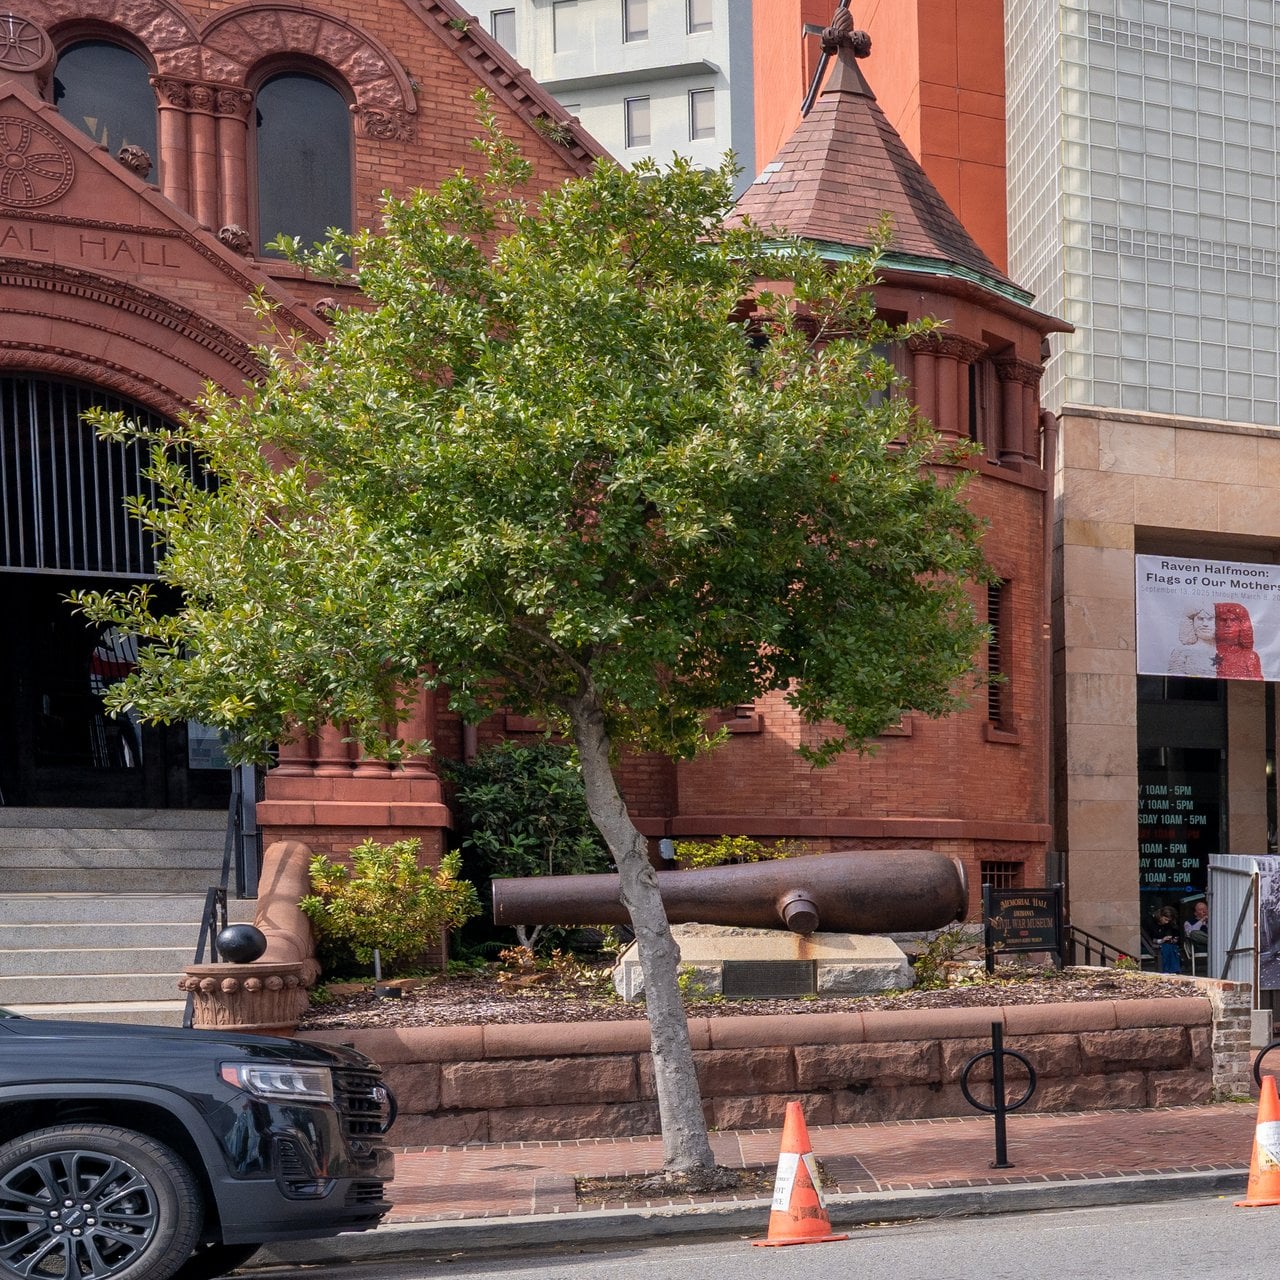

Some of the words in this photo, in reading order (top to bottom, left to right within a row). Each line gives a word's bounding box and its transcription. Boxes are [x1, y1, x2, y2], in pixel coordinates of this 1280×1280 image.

[79, 234, 181, 269] HALL
[1161, 561, 1200, 573] Raven
[1204, 564, 1270, 578] Halfmoon:
[1146, 572, 1181, 586] Flags
[1184, 576, 1197, 585] of
[1201, 577, 1226, 588] Our
[1141, 586, 1177, 595] September
[1212, 590, 1239, 600] through
[1241, 592, 1261, 600] March
[1146, 785, 1168, 795] 10AM
[1174, 785, 1192, 795] 5PM
[1148, 800, 1169, 810] 10AM
[1176, 800, 1194, 810] 5PM
[1161, 815, 1183, 825] 10AM
[1189, 815, 1207, 825] 5PM
[1141, 844, 1163, 854] 10AM
[1169, 844, 1187, 854] 5PM
[1154, 858, 1175, 868] 10AM
[1182, 858, 1200, 868] 5PM
[1145, 873, 1167, 883] 10AM
[1173, 873, 1191, 883] 5PM
